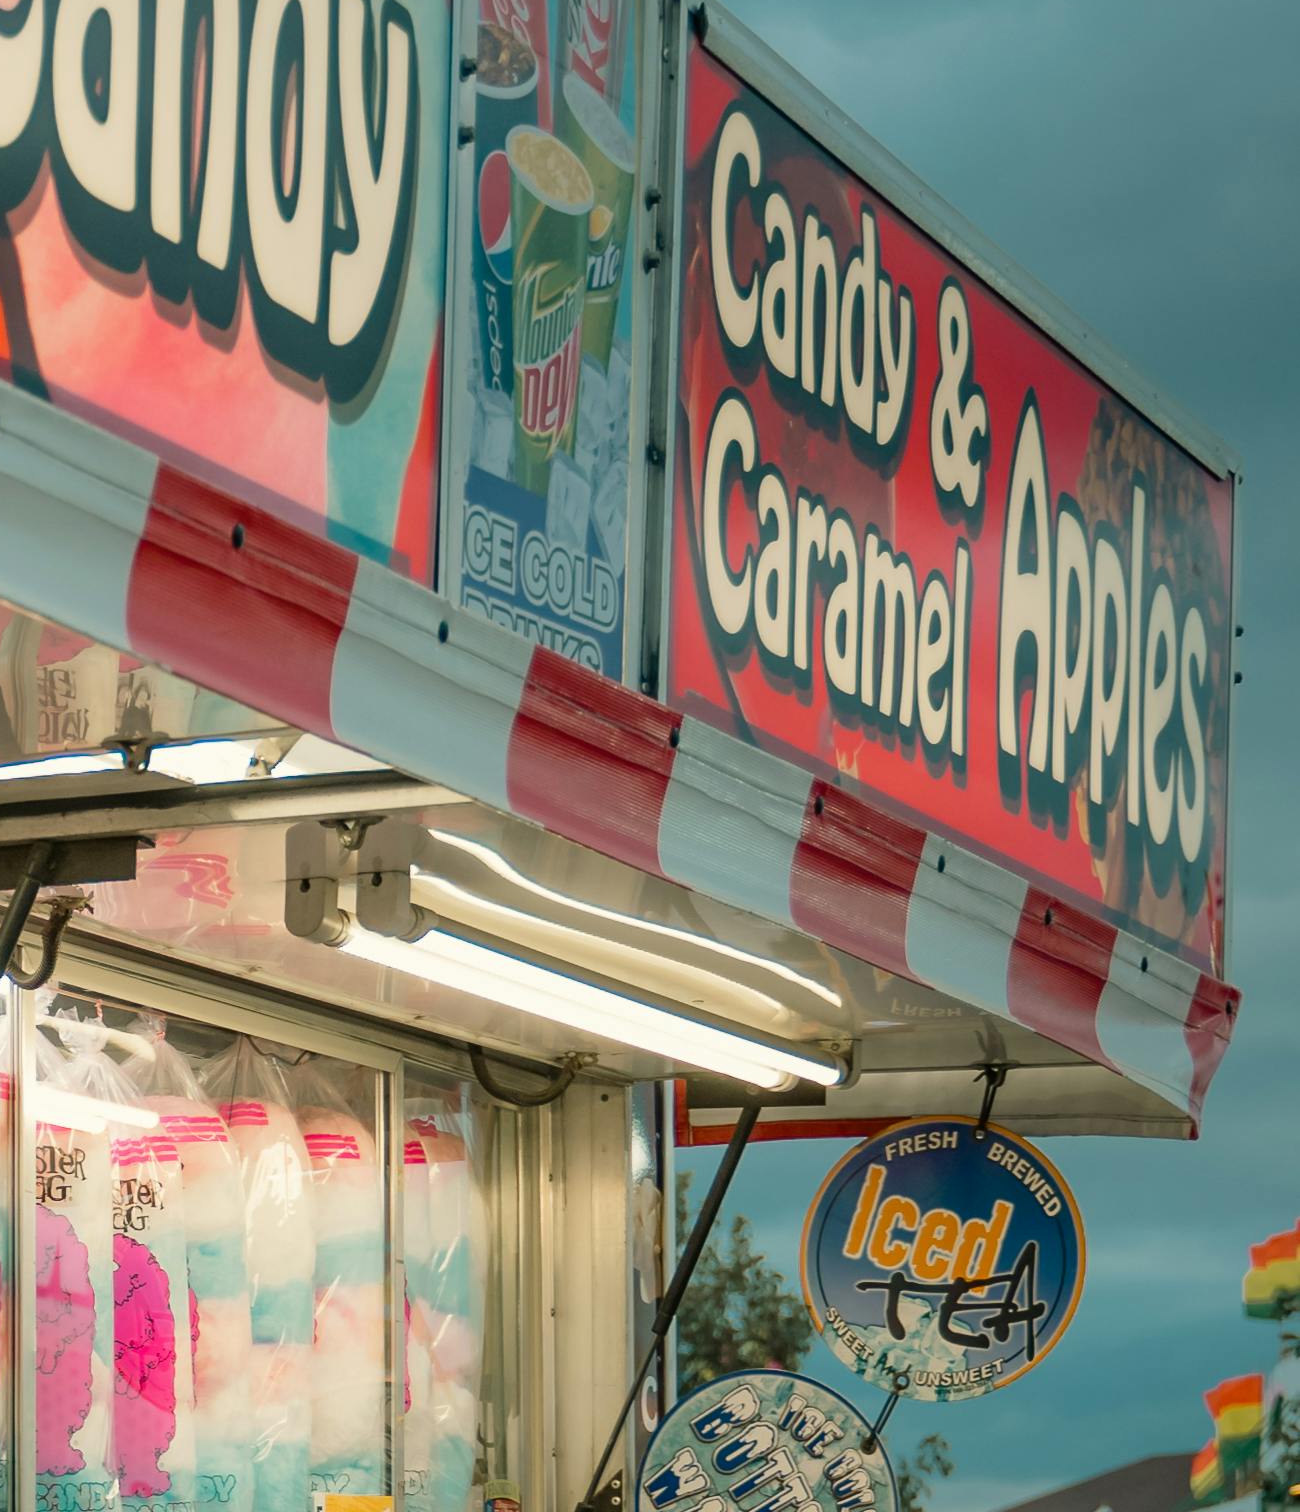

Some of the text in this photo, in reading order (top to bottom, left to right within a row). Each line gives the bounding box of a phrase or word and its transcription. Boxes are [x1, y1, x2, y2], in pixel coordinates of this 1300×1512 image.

[711, 109, 988, 508] Candy &
[463, 503, 517, 595] CE
[521, 530, 620, 634] COLD
[702, 396, 1208, 864] Caramel Apples
[843, 1163, 1014, 1298] Iced
[884, 1131, 1062, 1218] FRESH BREWED
[825, 1306, 1006, 1387] SWEET UNSWEET
[856, 1241, 1046, 1362] TEA
[778, 1392, 845, 1458] ICE
